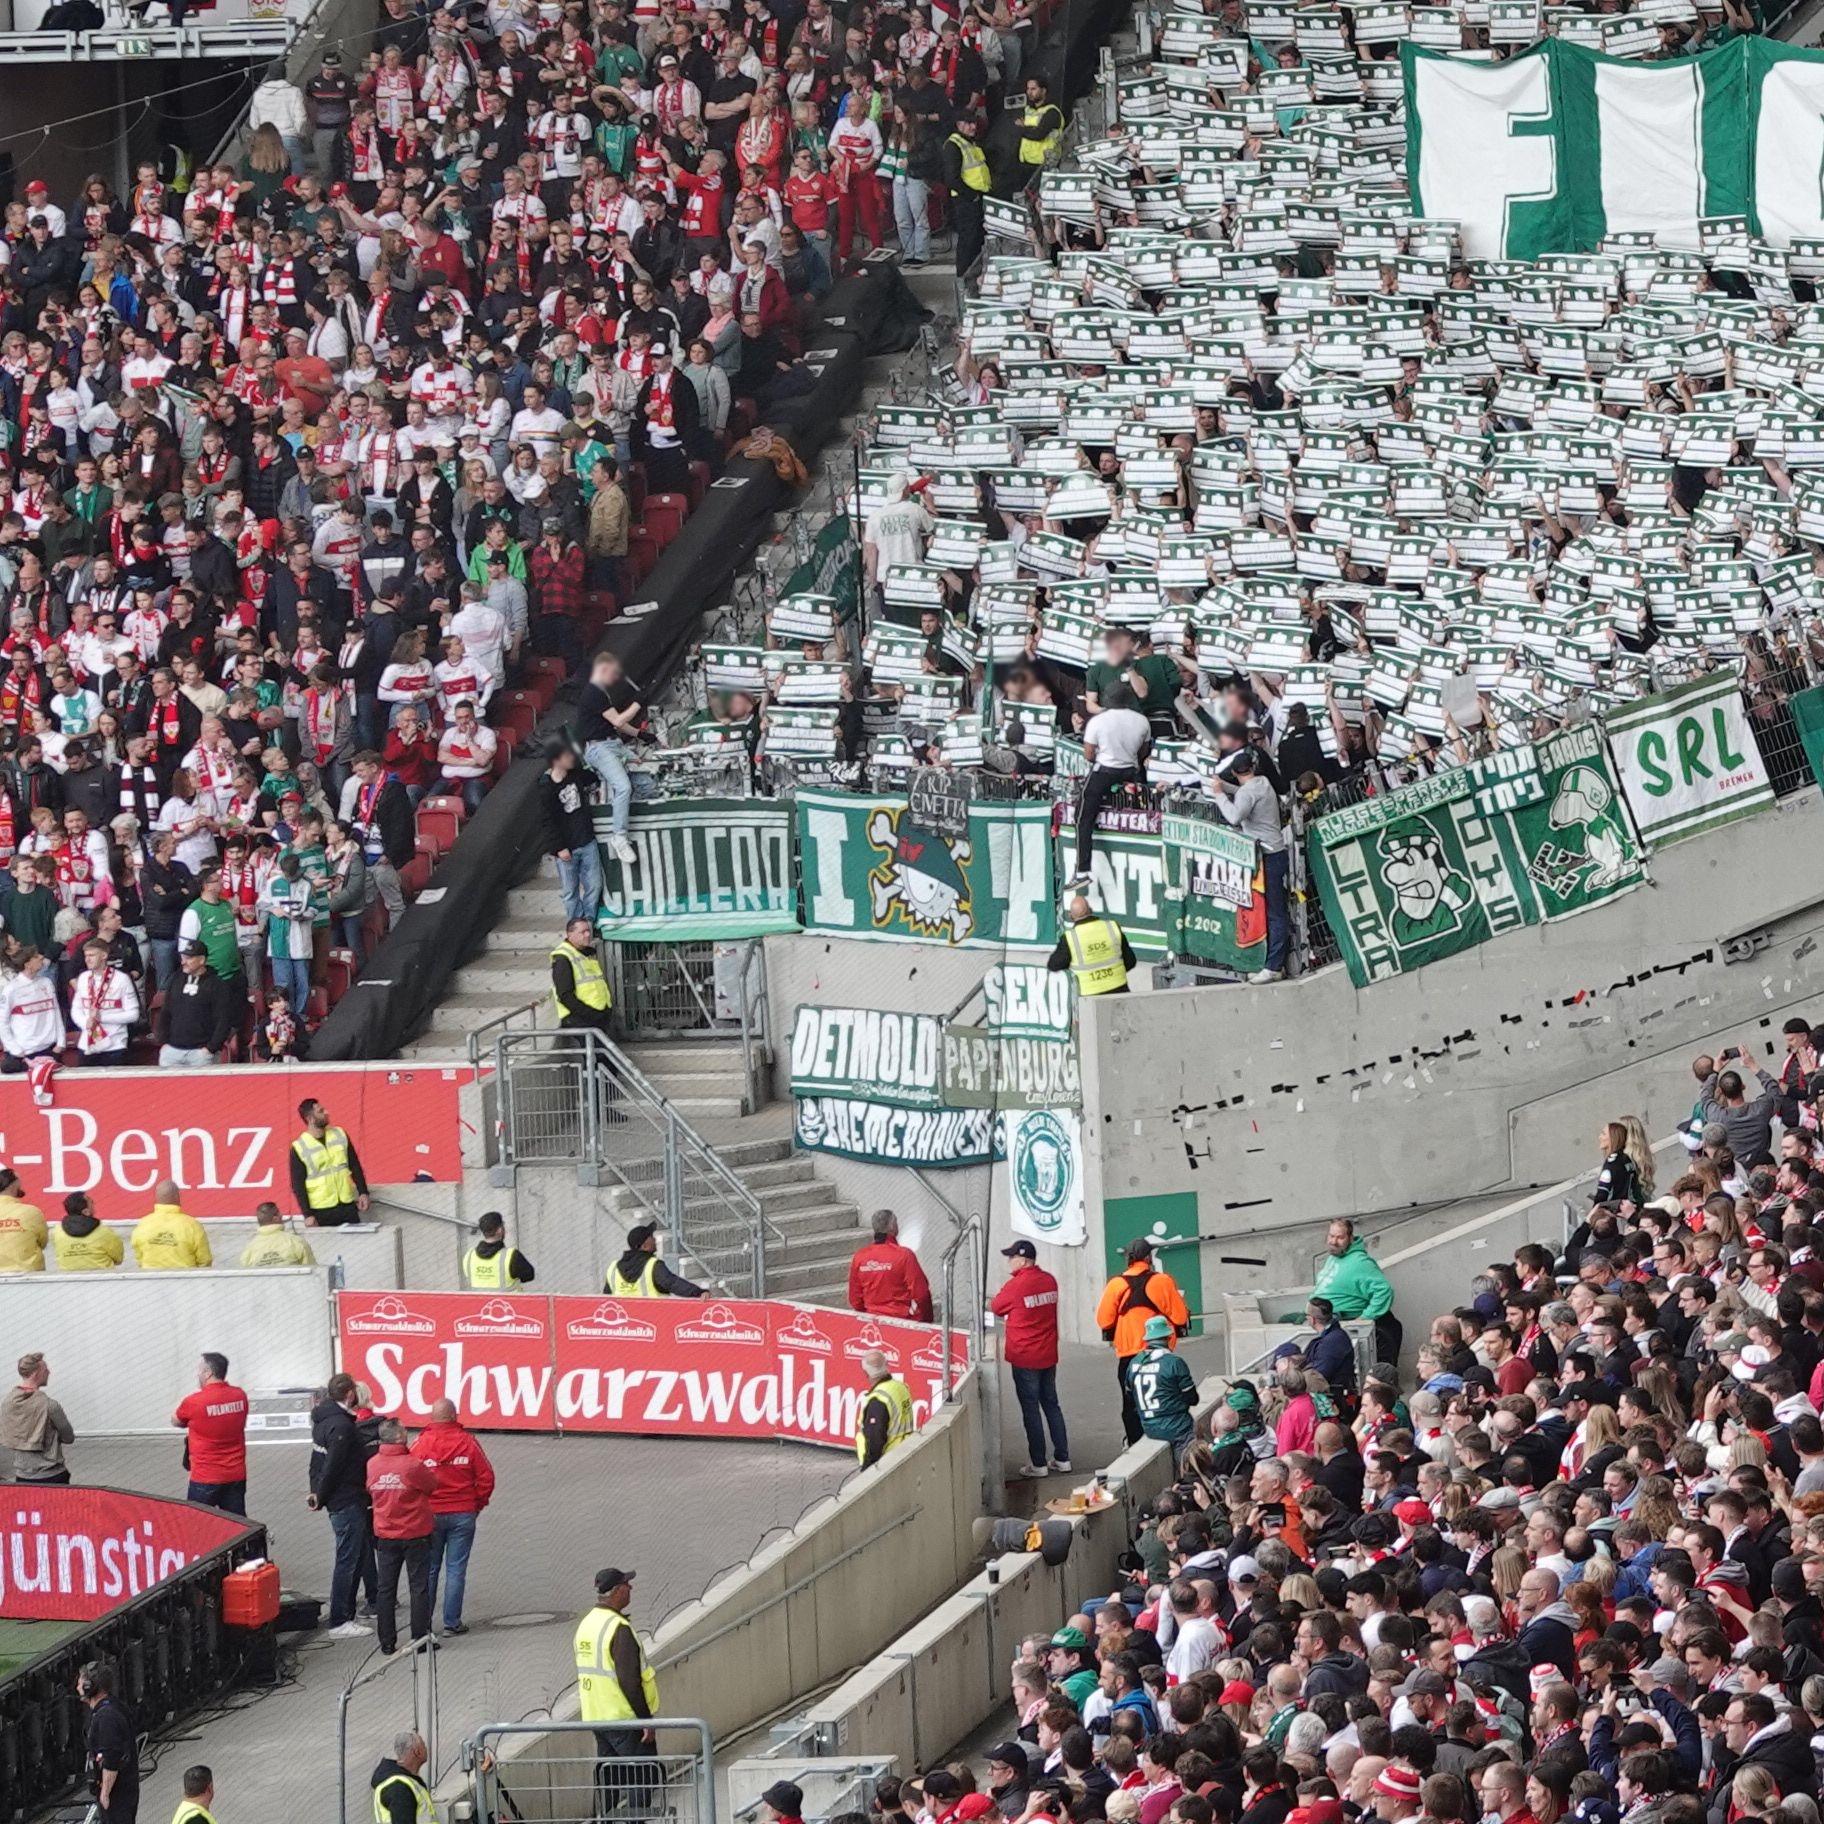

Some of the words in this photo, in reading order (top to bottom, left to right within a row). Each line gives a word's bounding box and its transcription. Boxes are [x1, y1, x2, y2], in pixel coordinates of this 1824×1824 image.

[1637, 706, 1746, 798] SRL
[1719, 771, 1755, 791] BREMEN
[1088, 941, 1107, 953] SDS
[985, 965, 1070, 1029] SEKO
[792, 1007, 938, 1088] DETMOLD
[944, 1036, 1079, 1094] PAPENBURG
[348, 1319, 436, 1335] Schwarzwaldmilch
[456, 1320, 542, 1337] Schwarzwaldmilch
[567, 1323, 657, 1340] Schwarzwaldmilch
[675, 1327, 764, 1343] Schwarzwaldmilch
[1133, 1373, 1160, 1412] 12
